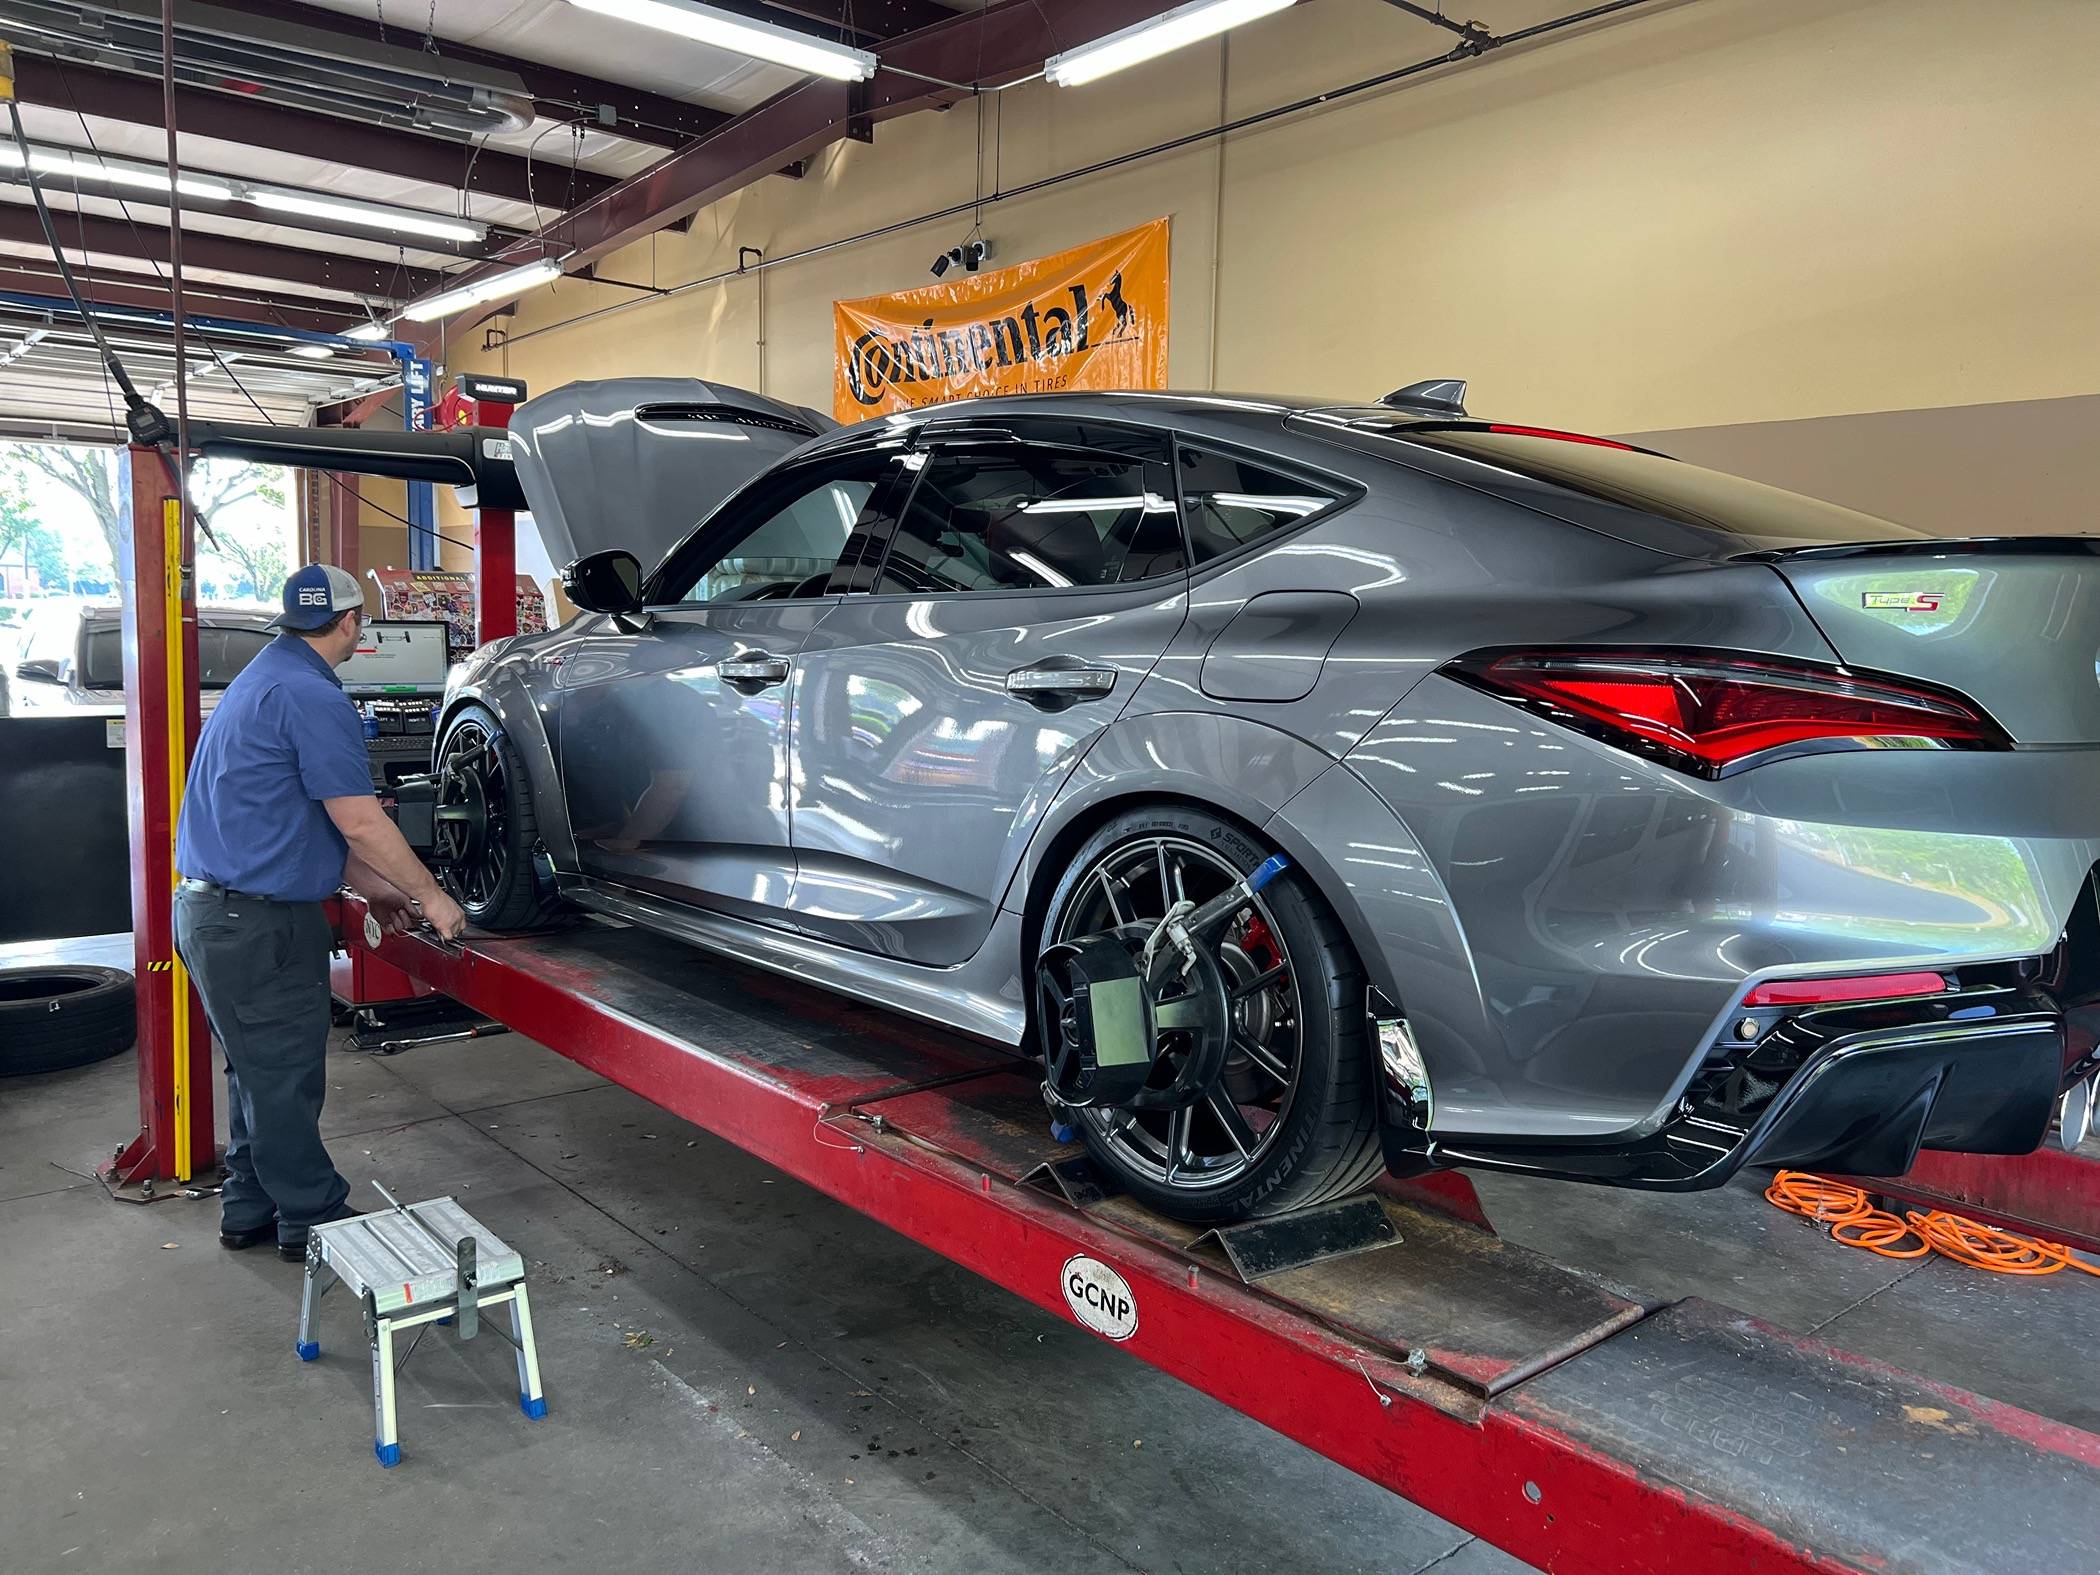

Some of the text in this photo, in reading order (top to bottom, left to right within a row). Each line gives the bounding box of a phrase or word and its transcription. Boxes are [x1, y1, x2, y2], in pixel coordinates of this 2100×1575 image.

[849, 284, 1090, 405] Continental
[474, 382, 518, 395] HUNTER
[1015, 382, 1028, 394] IN
[1034, 374, 1068, 392] TIRES
[410, 360, 425, 432] ARY LIFT
[299, 592, 328, 605] BG
[1906, 592, 1945, 612] S
[1069, 1273, 1130, 1321] GCNP
